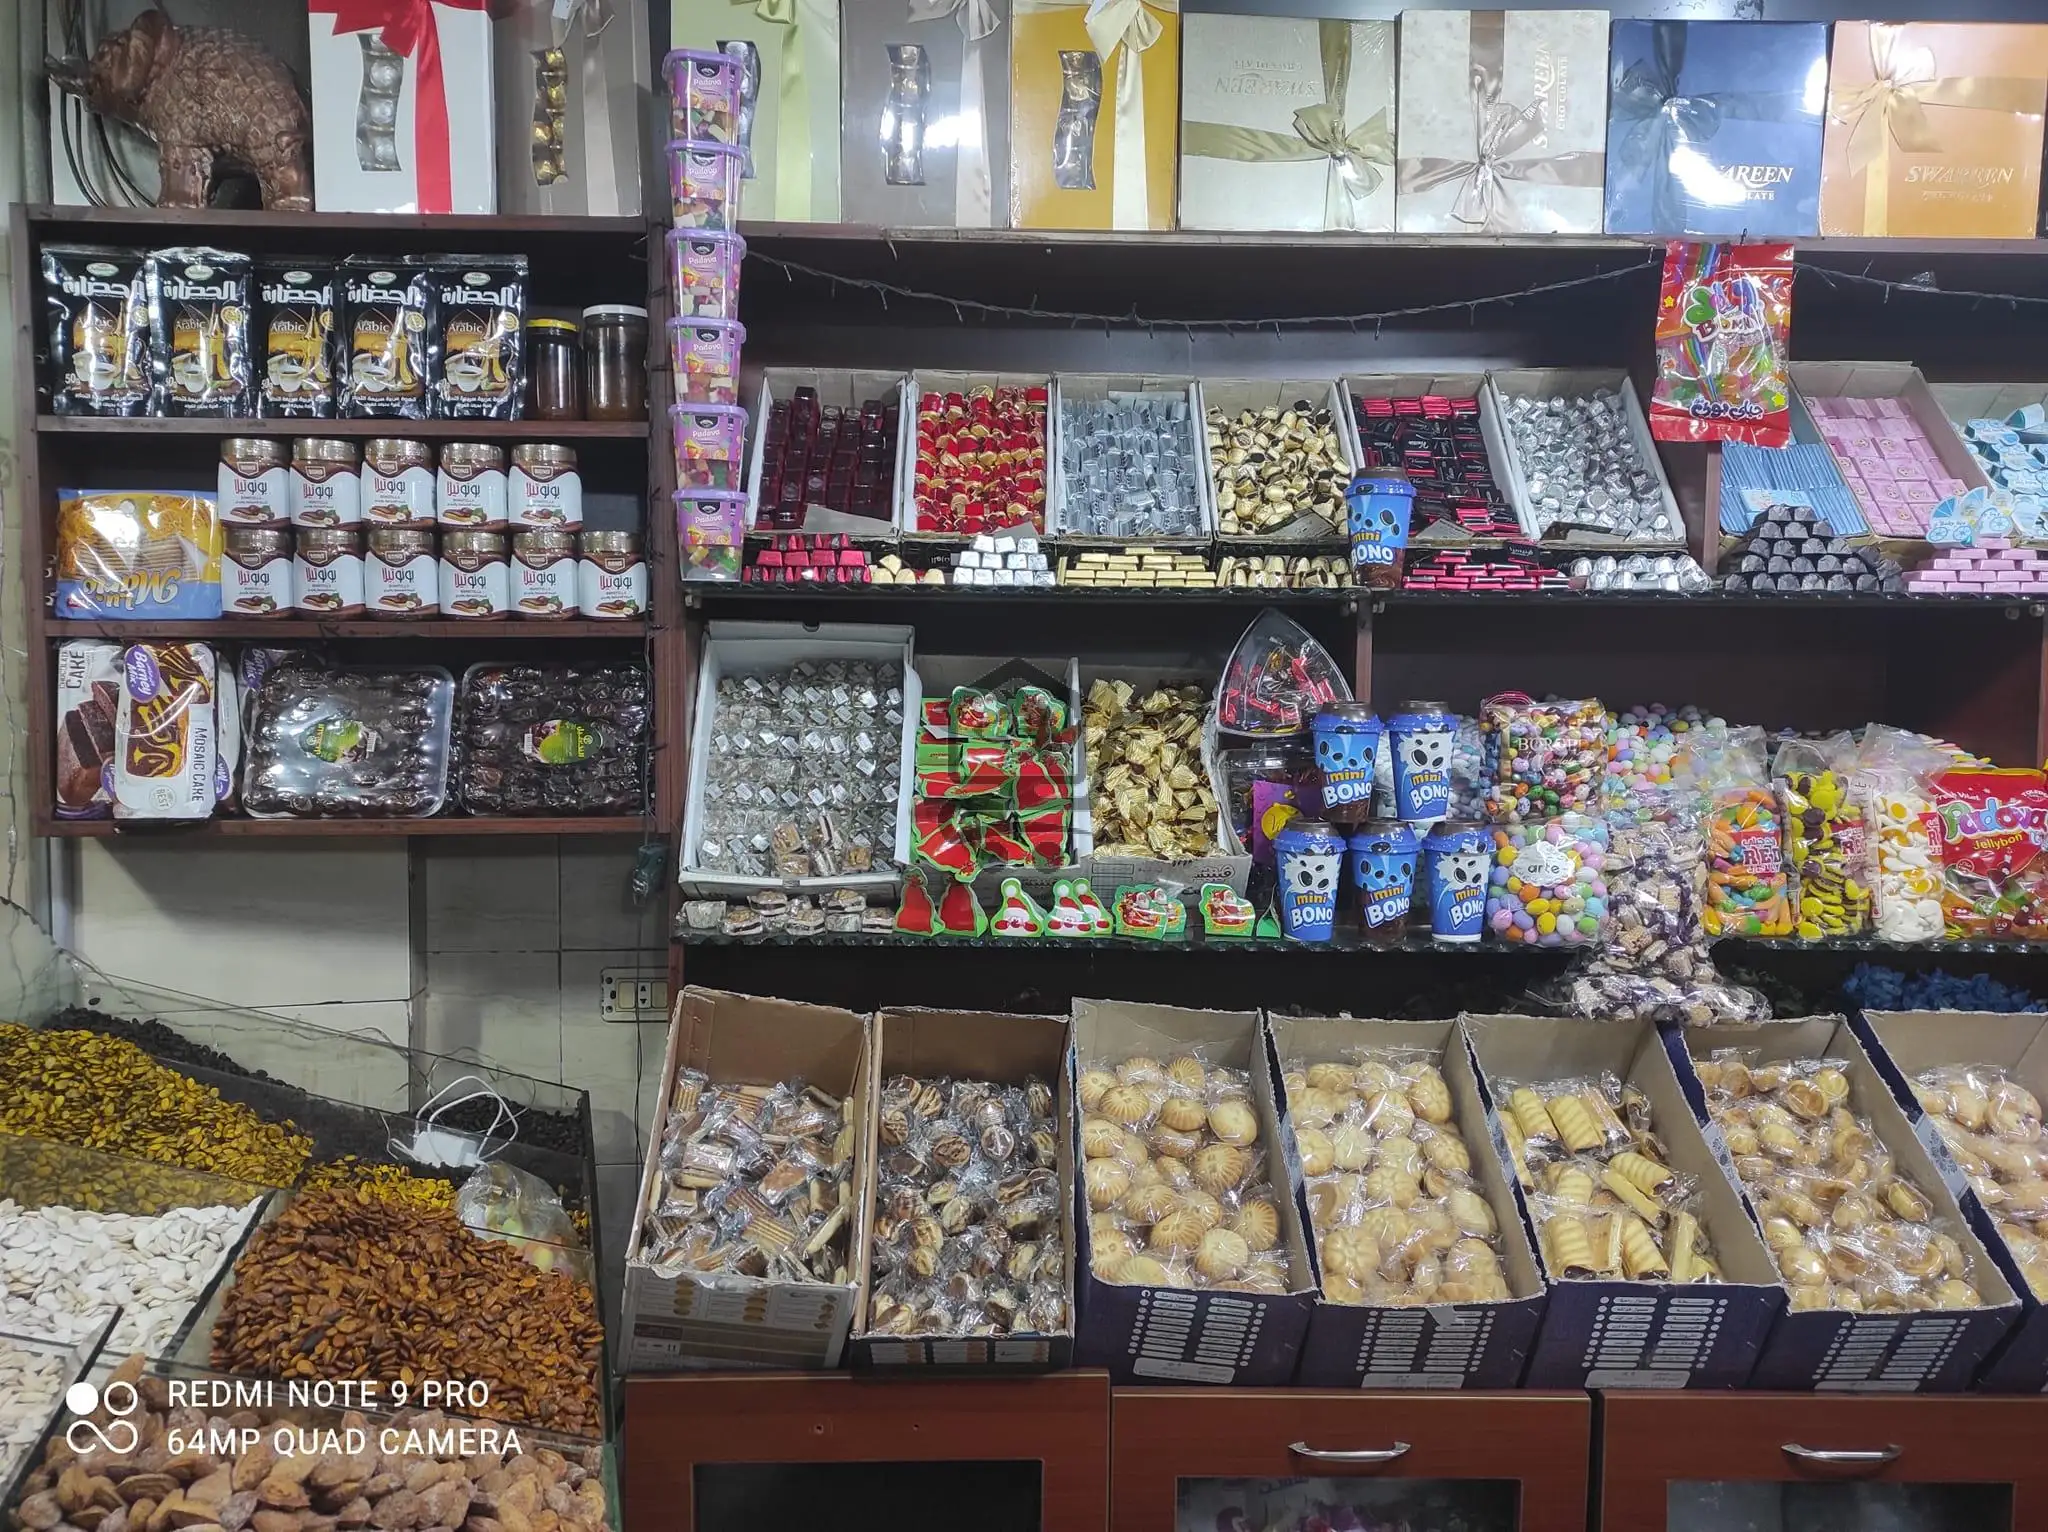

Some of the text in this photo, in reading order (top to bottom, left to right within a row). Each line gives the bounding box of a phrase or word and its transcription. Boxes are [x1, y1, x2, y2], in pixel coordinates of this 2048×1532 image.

[693, 77, 722, 87] Padova
[1533, 42, 1555, 149] SAREEN
[688, 255, 717, 265] Padova
[163, 276, 238, 301] الحضارة
[261, 282, 333, 306] الحضارة
[348, 283, 424, 307] الحضارة
[441, 285, 516, 308] الحضارة
[175, 317, 206, 329] Arabic
[271, 321, 306, 332] Arabic
[356, 321, 390, 333] Arabic
[449, 322, 484, 333] Arabic
[235, 478, 268, 496] بونوتيلا
[303, 483, 334, 501] بونوتيلا
[374, 477, 406, 495] بونوتيلا
[447, 481, 481, 498] بونوتيلا
[526, 481, 560, 500] بونوتيلا
[695, 513, 723, 524] Padova
[238, 569, 270, 587] بونوتيلا
[305, 566, 337, 584] بونوتيلا
[381, 566, 415, 584] بونوتيلا
[454, 573, 487, 590] بونوتيلا
[523, 569, 556, 587] بونوتيلا
[599, 574, 633, 591] بونوتيلا
[66, 648, 86, 690] CAKE
[126, 662, 136, 684] Mix
[133, 650, 152, 696] Barney
[1329, 768, 1365, 783] mini
[1411, 772, 1443, 785] mini
[1323, 781, 1373, 806] BONO
[1410, 784, 1449, 810] BONO
[1937, 796, 2048, 845] Padova
[1974, 832, 2023, 850] Jellybon
[1527, 862, 1560, 874] arte
[1296, 892, 1327, 904] mini
[1373, 886, 1404, 901] mini
[1455, 887, 1481, 901] mini
[1291, 907, 1333, 927] BONO
[1366, 896, 1410, 926] BONO
[1450, 900, 1485, 927] BONO
